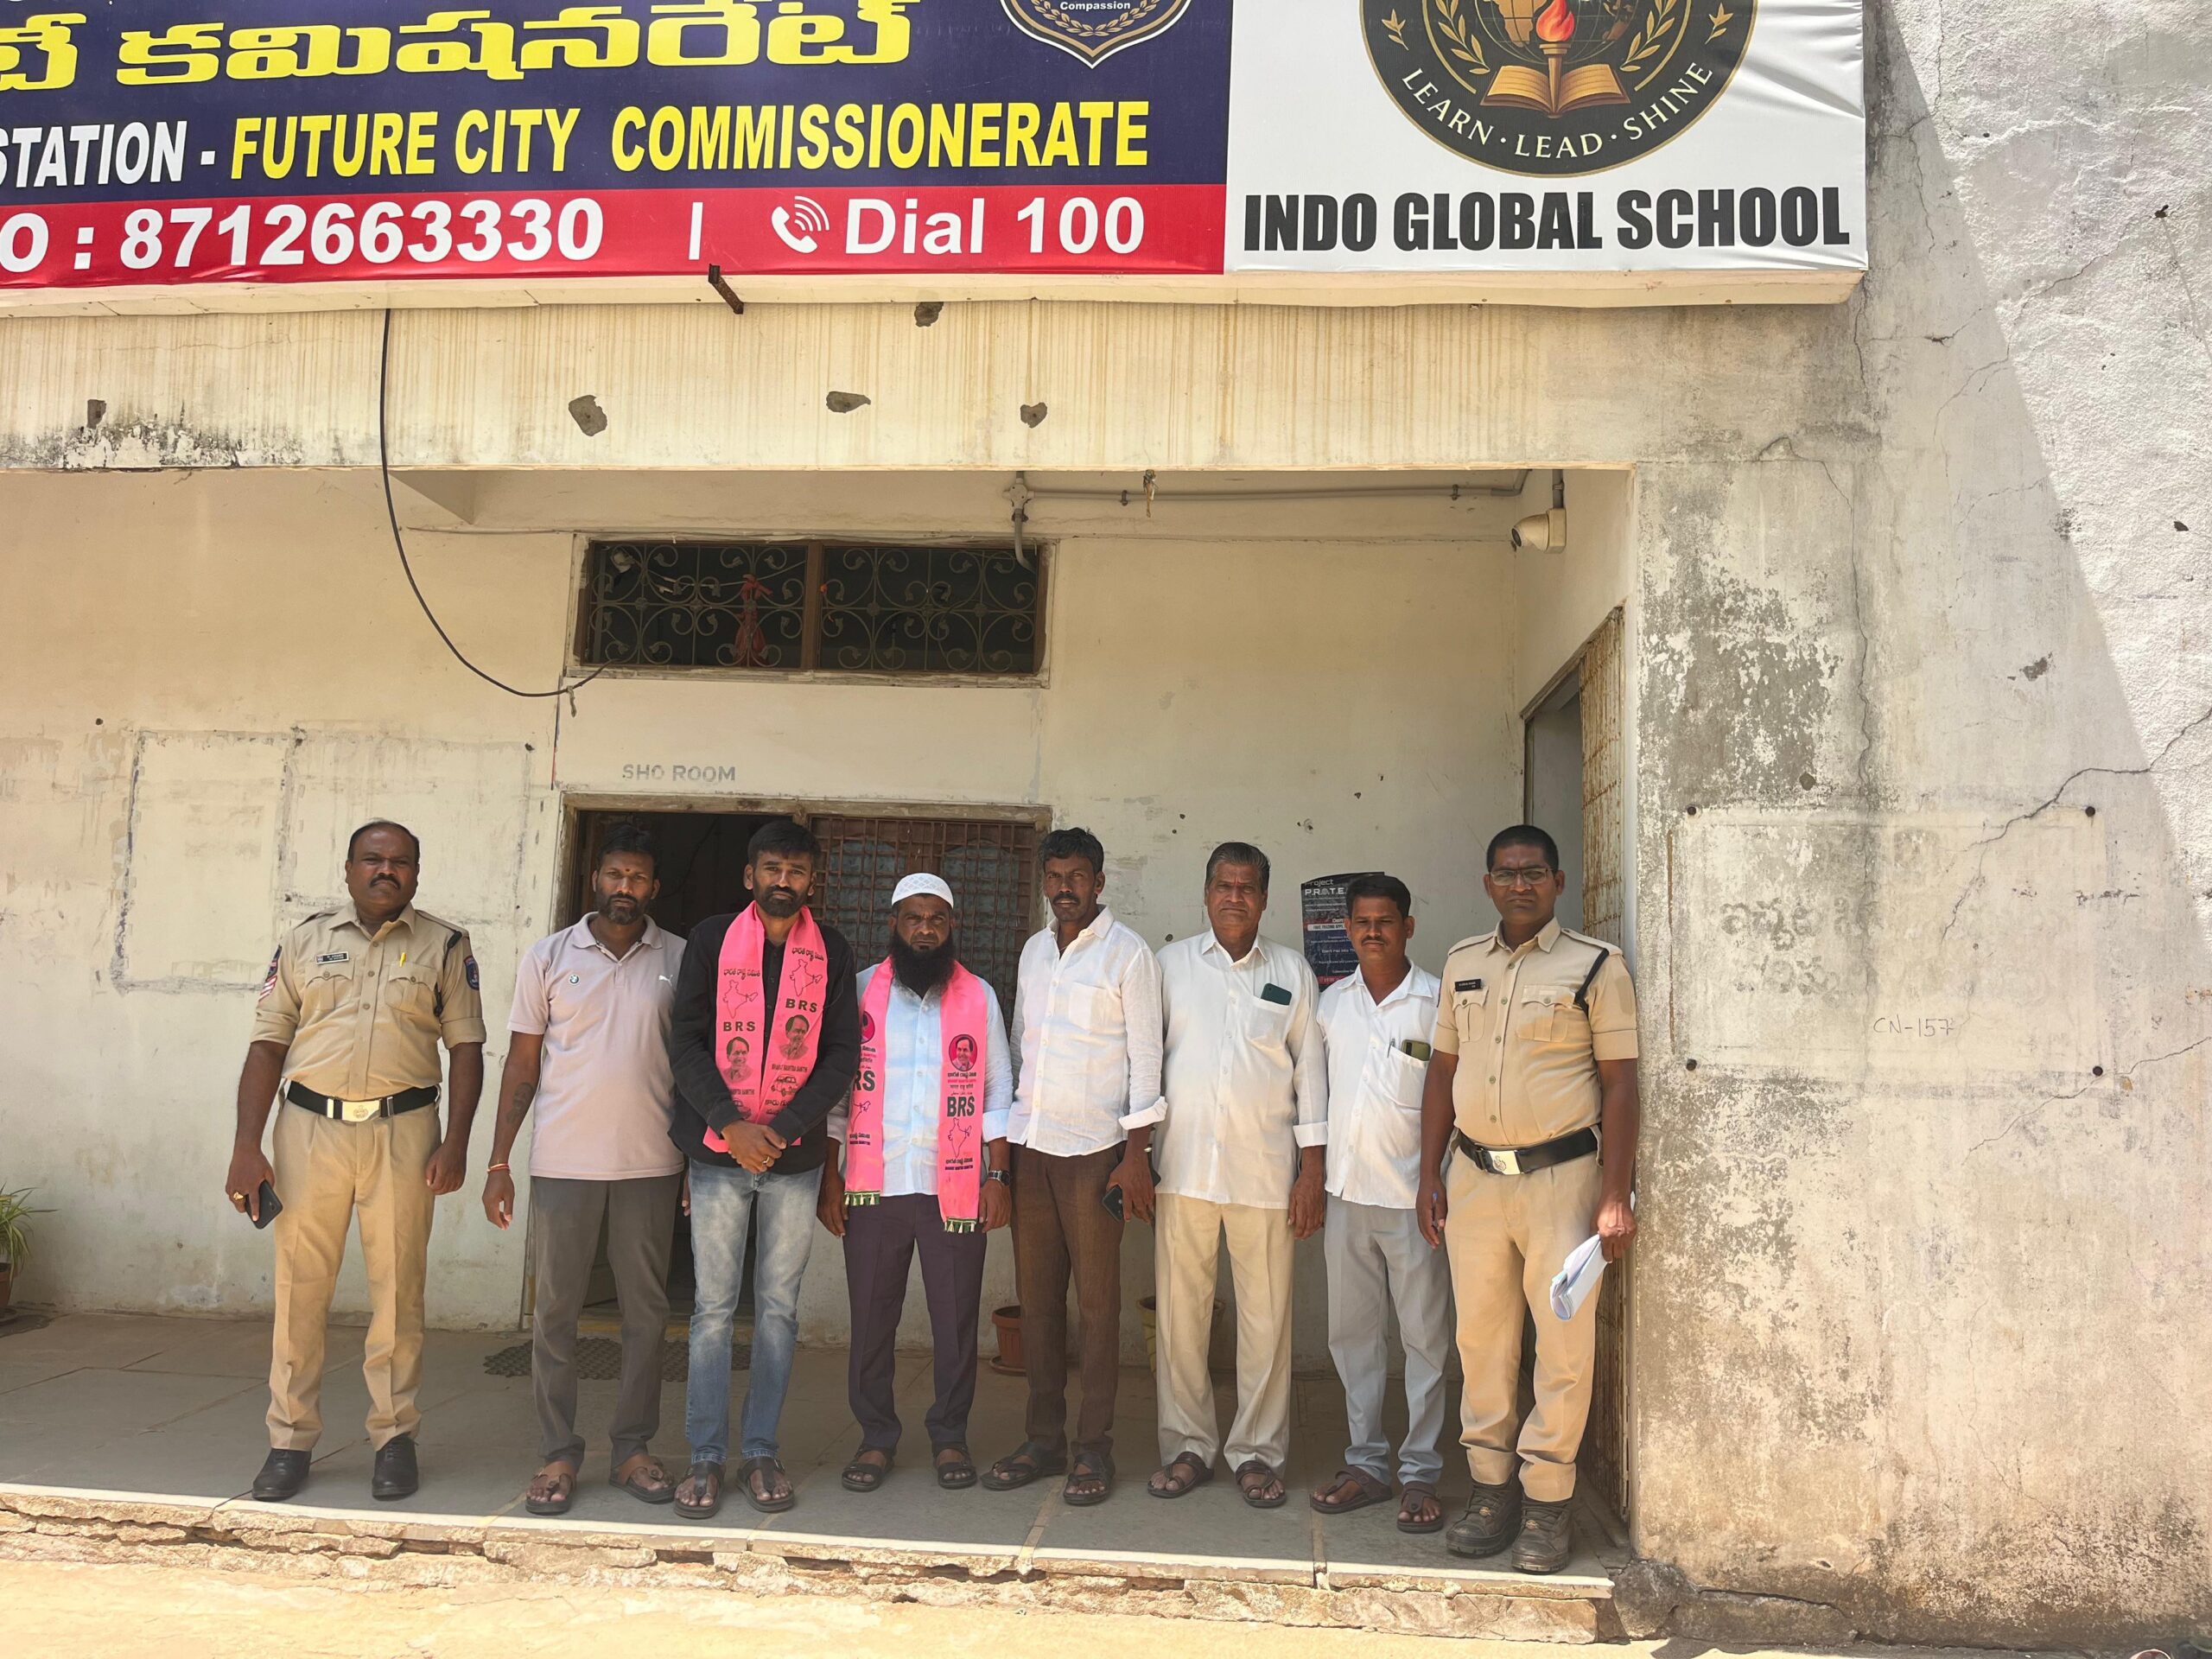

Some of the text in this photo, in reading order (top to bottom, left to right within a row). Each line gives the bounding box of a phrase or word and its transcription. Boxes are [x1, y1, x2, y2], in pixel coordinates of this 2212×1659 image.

[1060, 1, 1130, 11] Compassion
[117, 0, 921, 87] కమిషనరేట్
[1402, 62, 1713, 158] LEARN LEAD SHINE
[231, 111, 437, 180] FUTURE
[455, 108, 581, 173] CITY
[611, 101, 1149, 172] COMMISSIONERATE
[1244, 186, 1850, 251] INDO GLOBAL SCHOOL
[119, 197, 603, 268] 8712663330
[845, 197, 985, 255] Dial
[1016, 196, 1145, 254] 100
[622, 764, 735, 782] SHO ROOM
[785, 998, 817, 1013] BRS
[723, 1021, 755, 1032] BRS
[852, 1070, 875, 1092] RS
[946, 1096, 976, 1117] BRS
